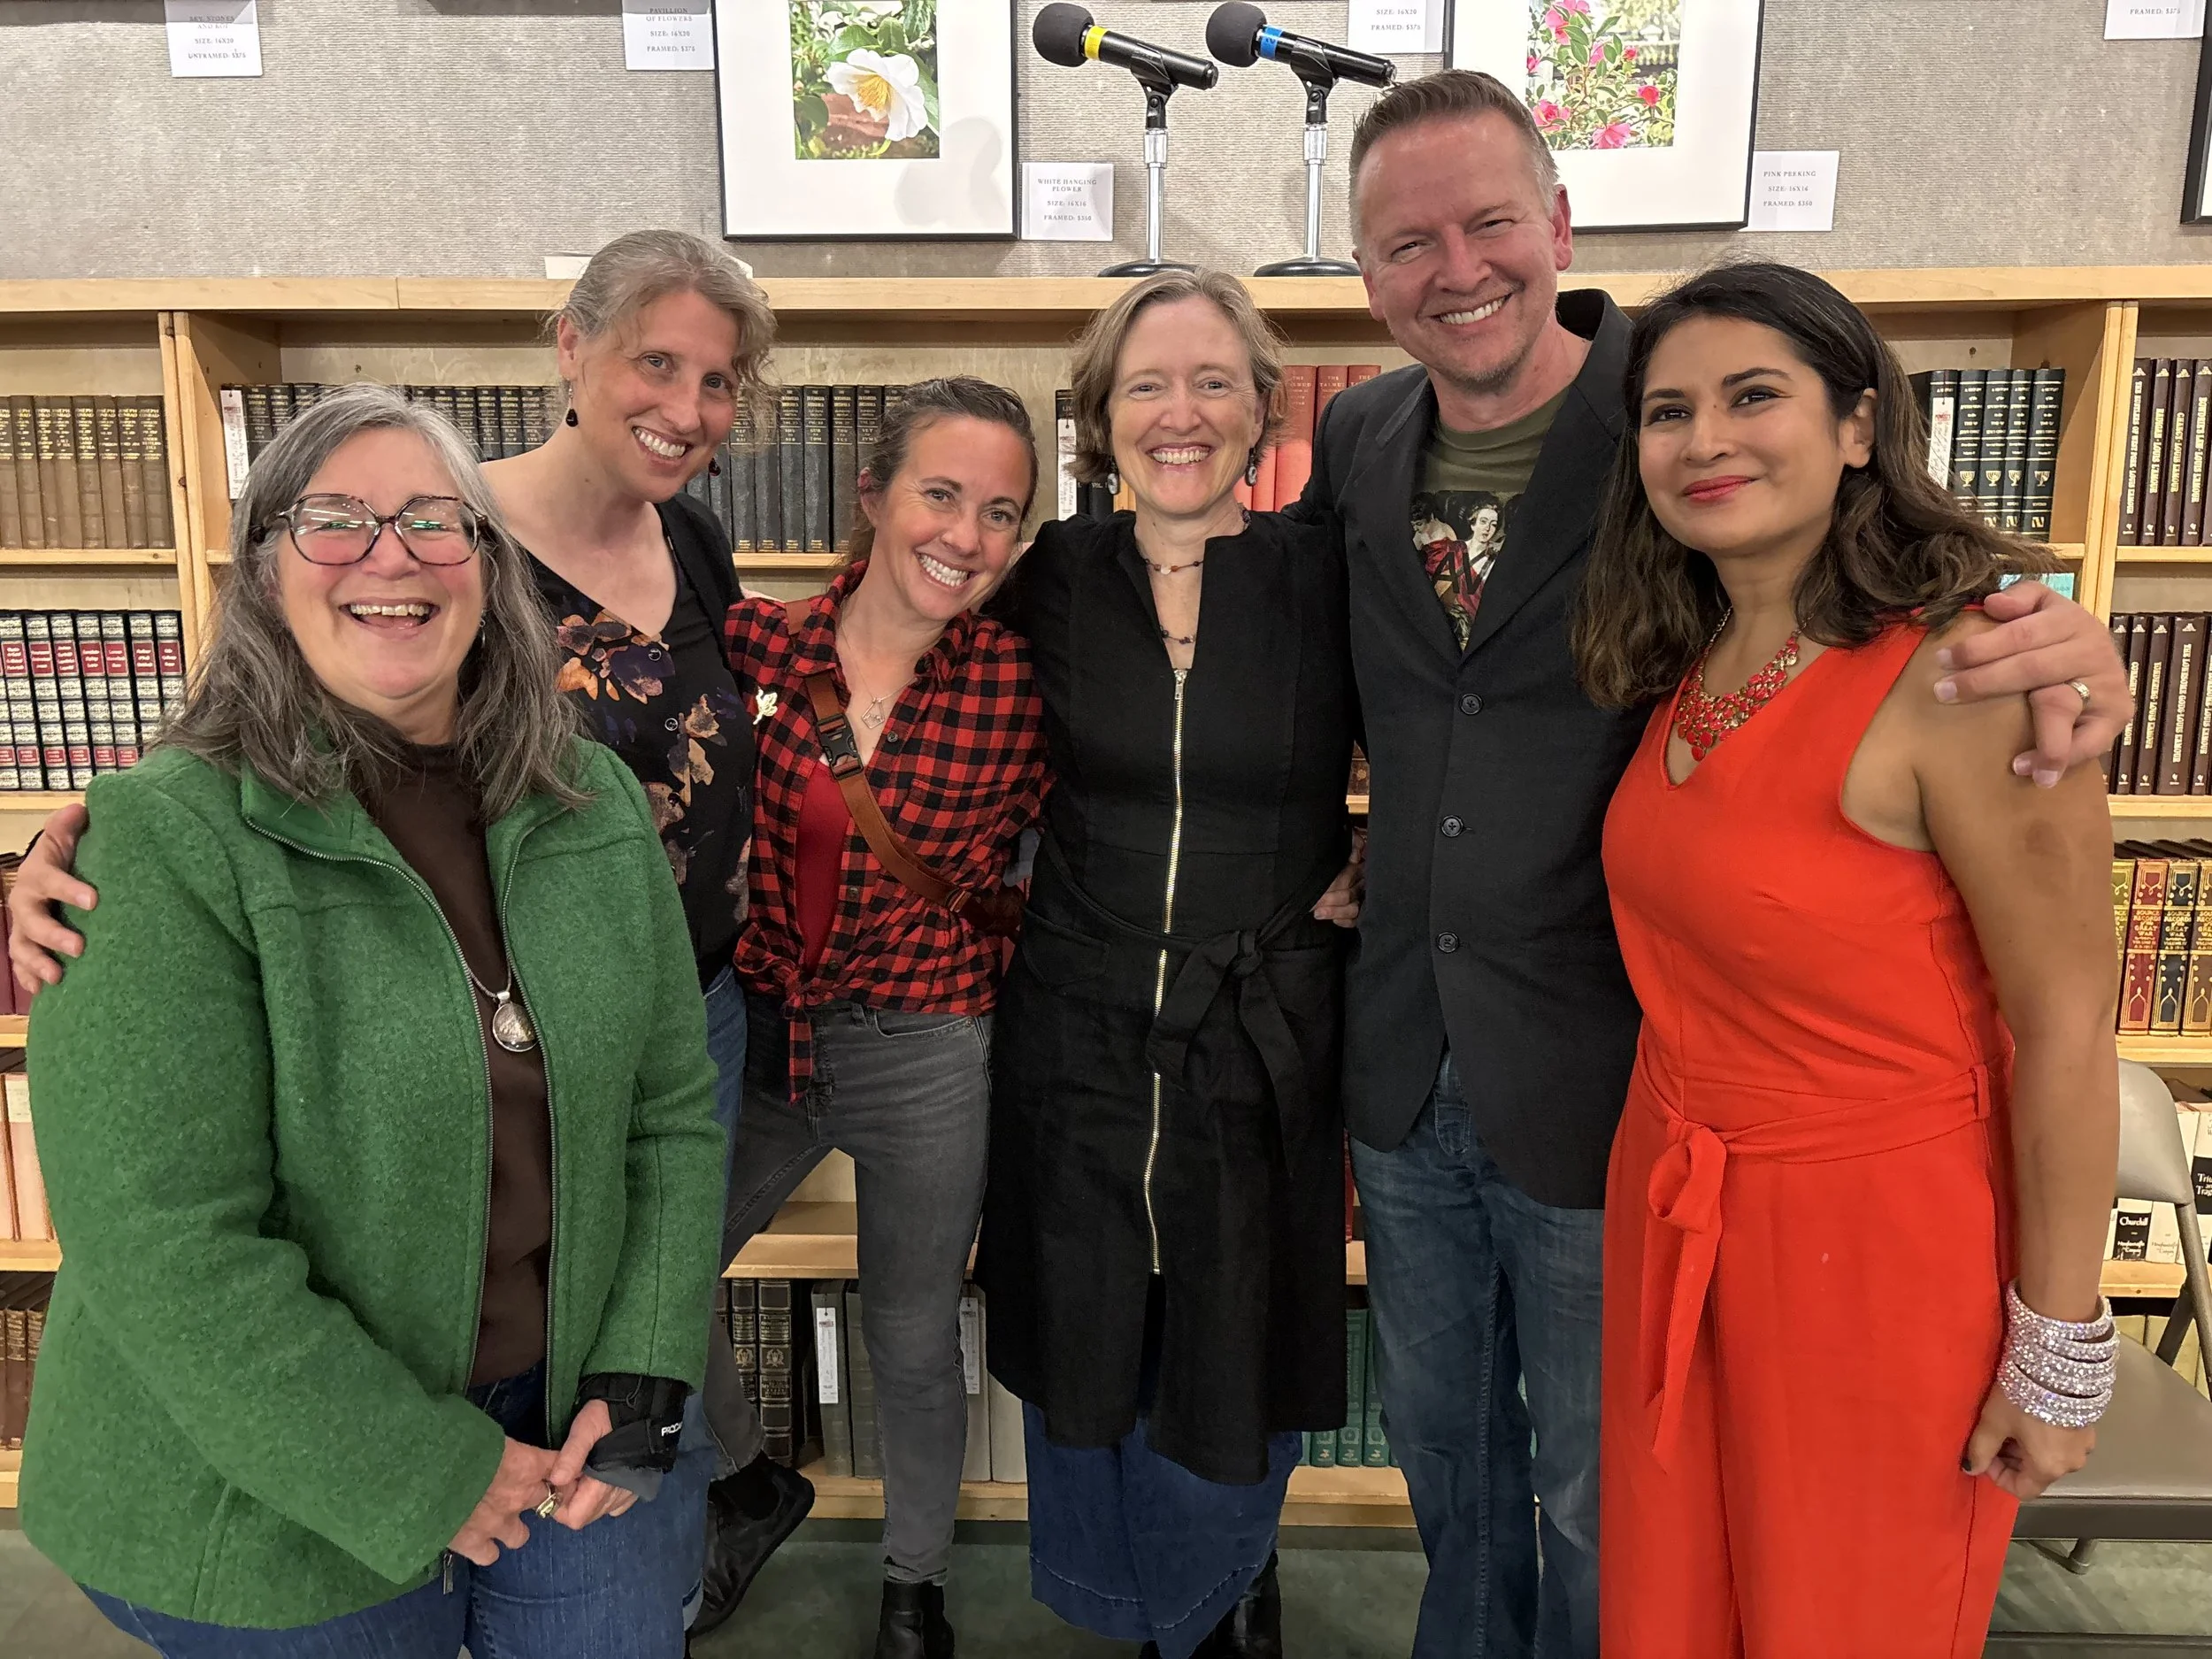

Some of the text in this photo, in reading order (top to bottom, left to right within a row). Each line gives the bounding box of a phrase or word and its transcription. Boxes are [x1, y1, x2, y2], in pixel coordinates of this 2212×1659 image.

[2152, 442, 2162, 463] LOUIS
[2173, 442, 2182, 463] LOUIS
[2193, 451, 2203, 472] LOUIS
[2128, 470, 2137, 488] LOUIS
[2149, 464, 2160, 494] L'AMOUR
[2191, 473, 2201, 503] L'AMOUR
[2148, 702, 2157, 721] LOUIS
[2176, 713, 2185, 733] LOUIS
[2119, 1216, 2149, 1226] Churchill
